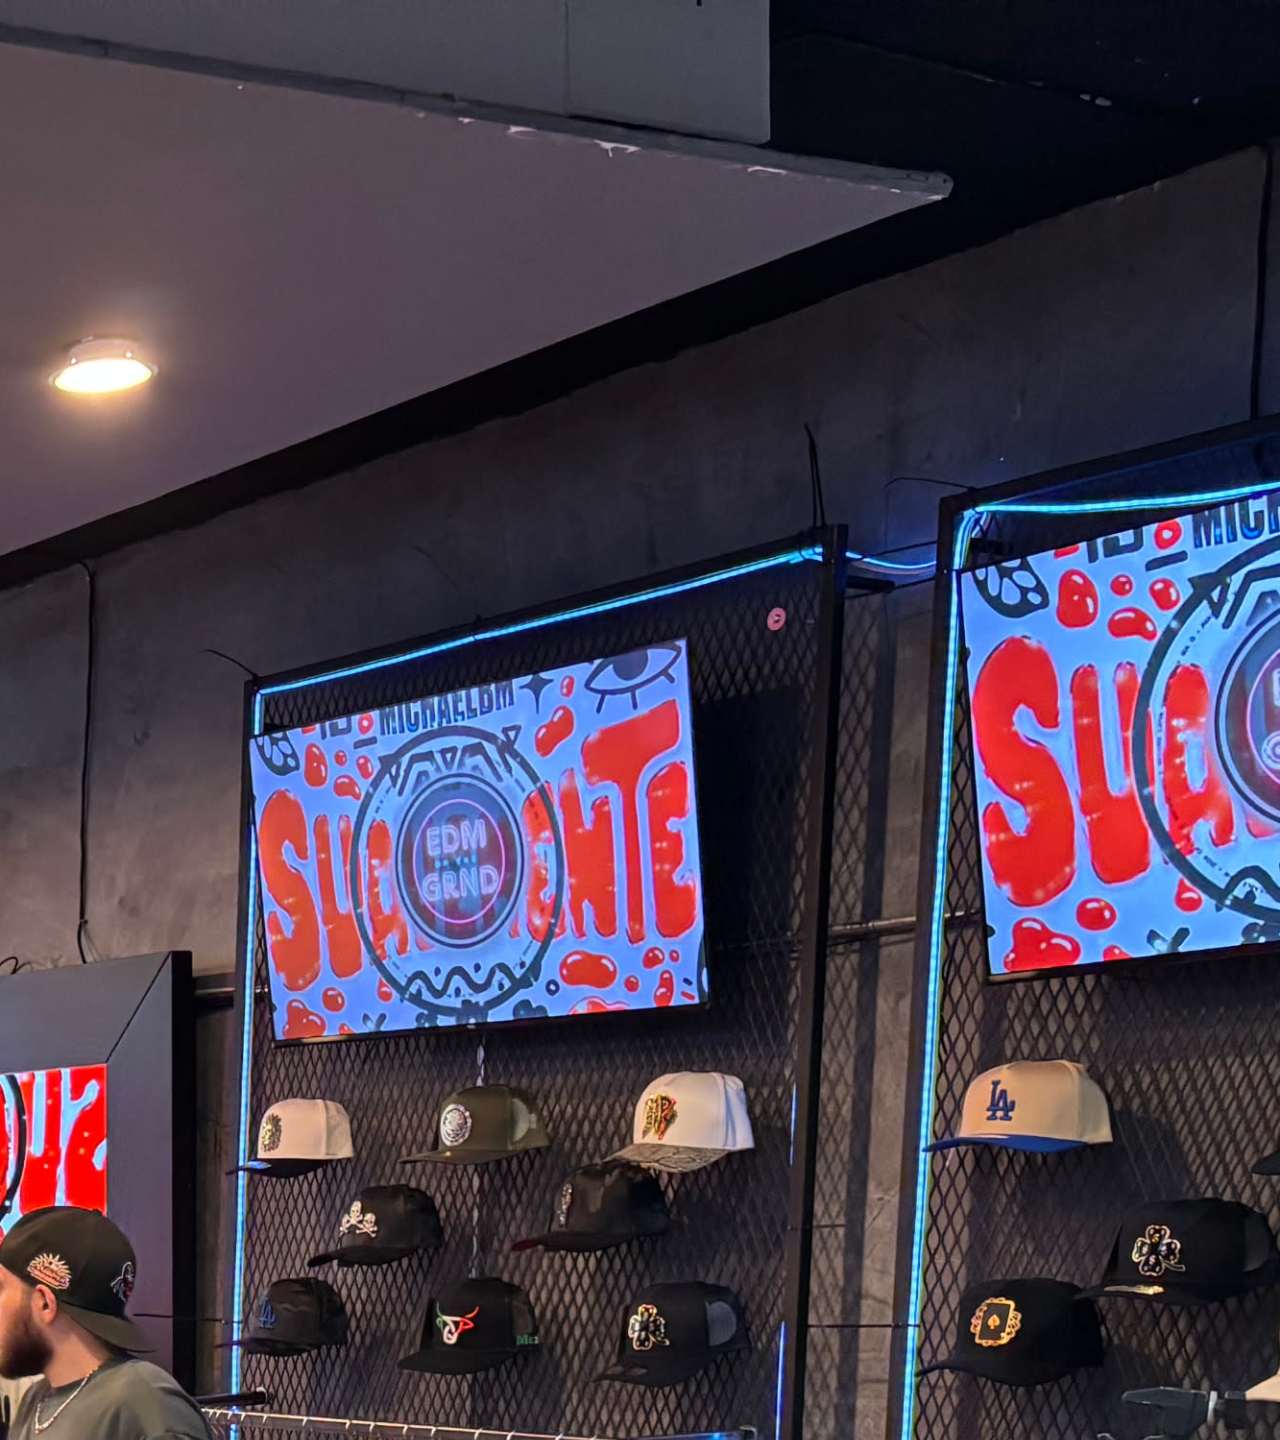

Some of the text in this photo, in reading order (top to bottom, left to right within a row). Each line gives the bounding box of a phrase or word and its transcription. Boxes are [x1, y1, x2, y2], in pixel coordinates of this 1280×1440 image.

[426, 818, 487, 857] EDM
[422, 864, 499, 902] GRND
[985, 1079, 1016, 1122] LA
